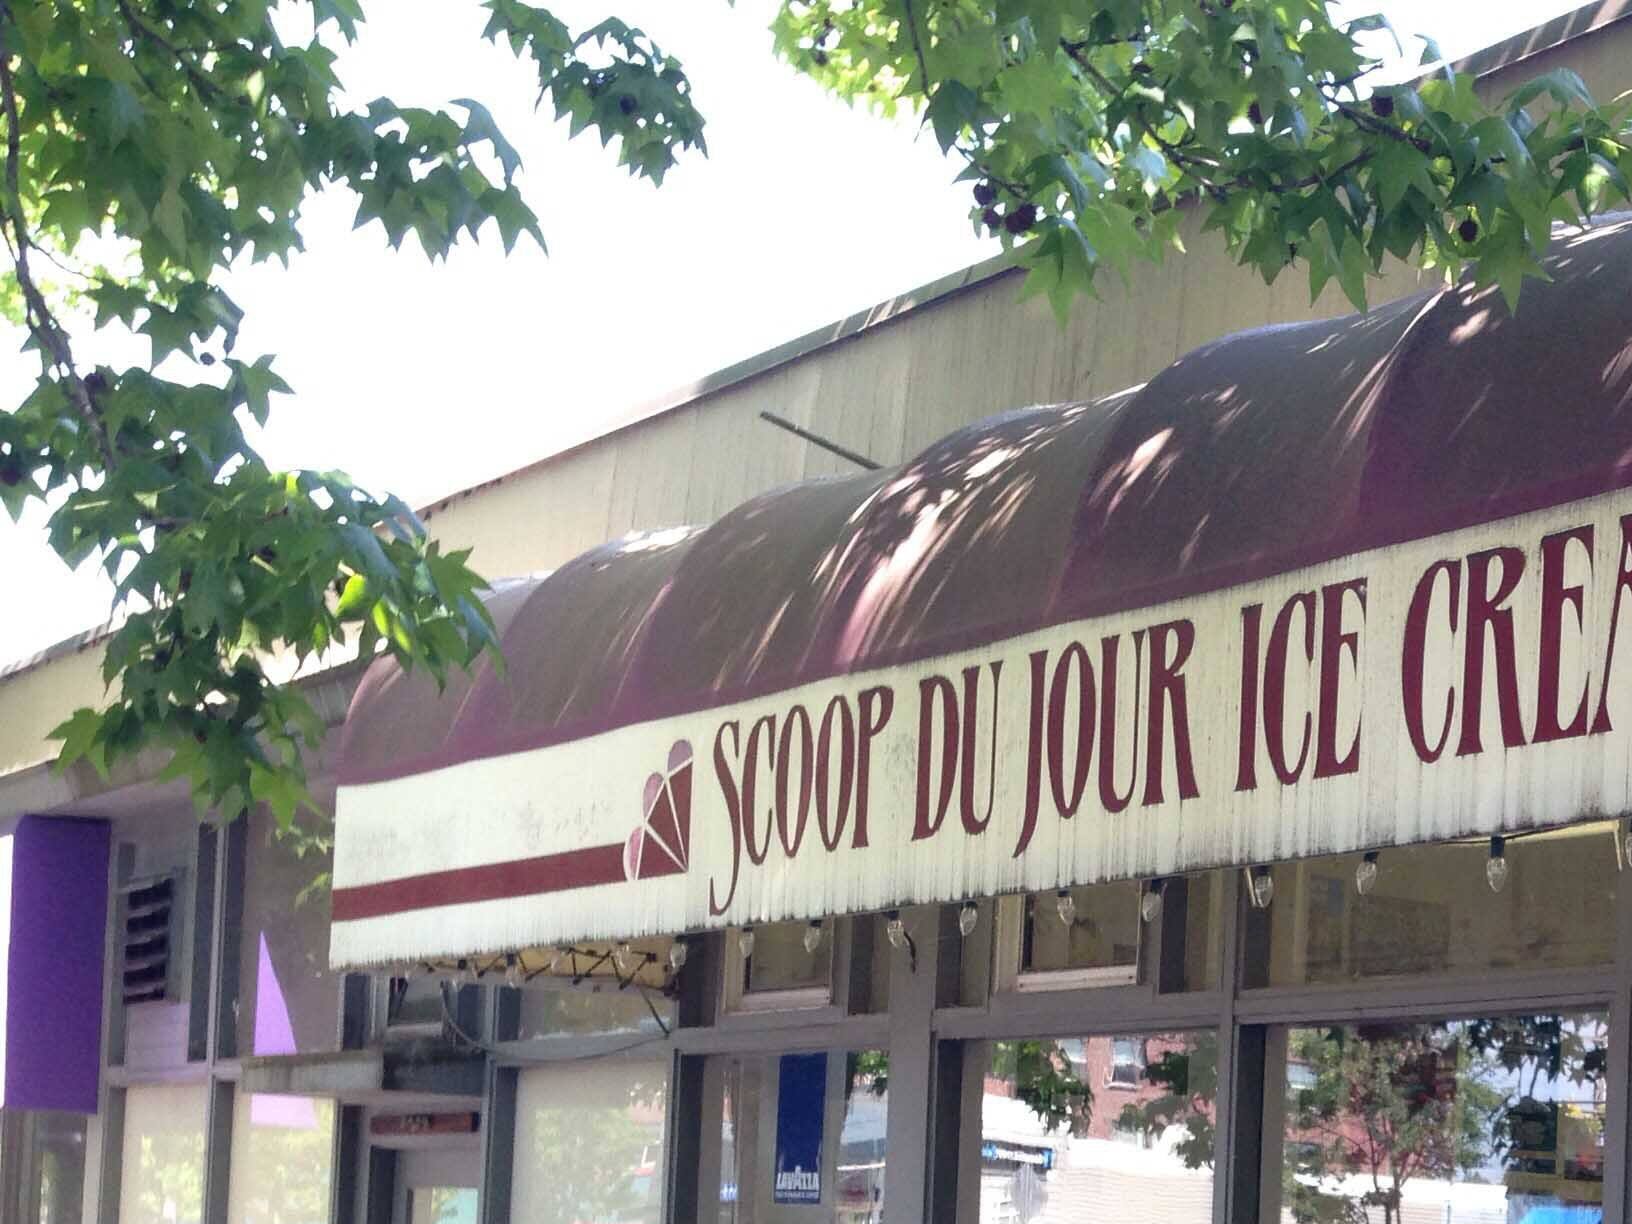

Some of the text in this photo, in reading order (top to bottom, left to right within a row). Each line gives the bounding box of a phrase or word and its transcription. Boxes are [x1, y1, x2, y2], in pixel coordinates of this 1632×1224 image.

[709, 685, 894, 916] SCOOP
[910, 660, 1003, 842] DU
[1013, 618, 1200, 858] JOUR
[1235, 577, 1368, 792] ICE
[776, 1165, 820, 1191] LAVAZZA
